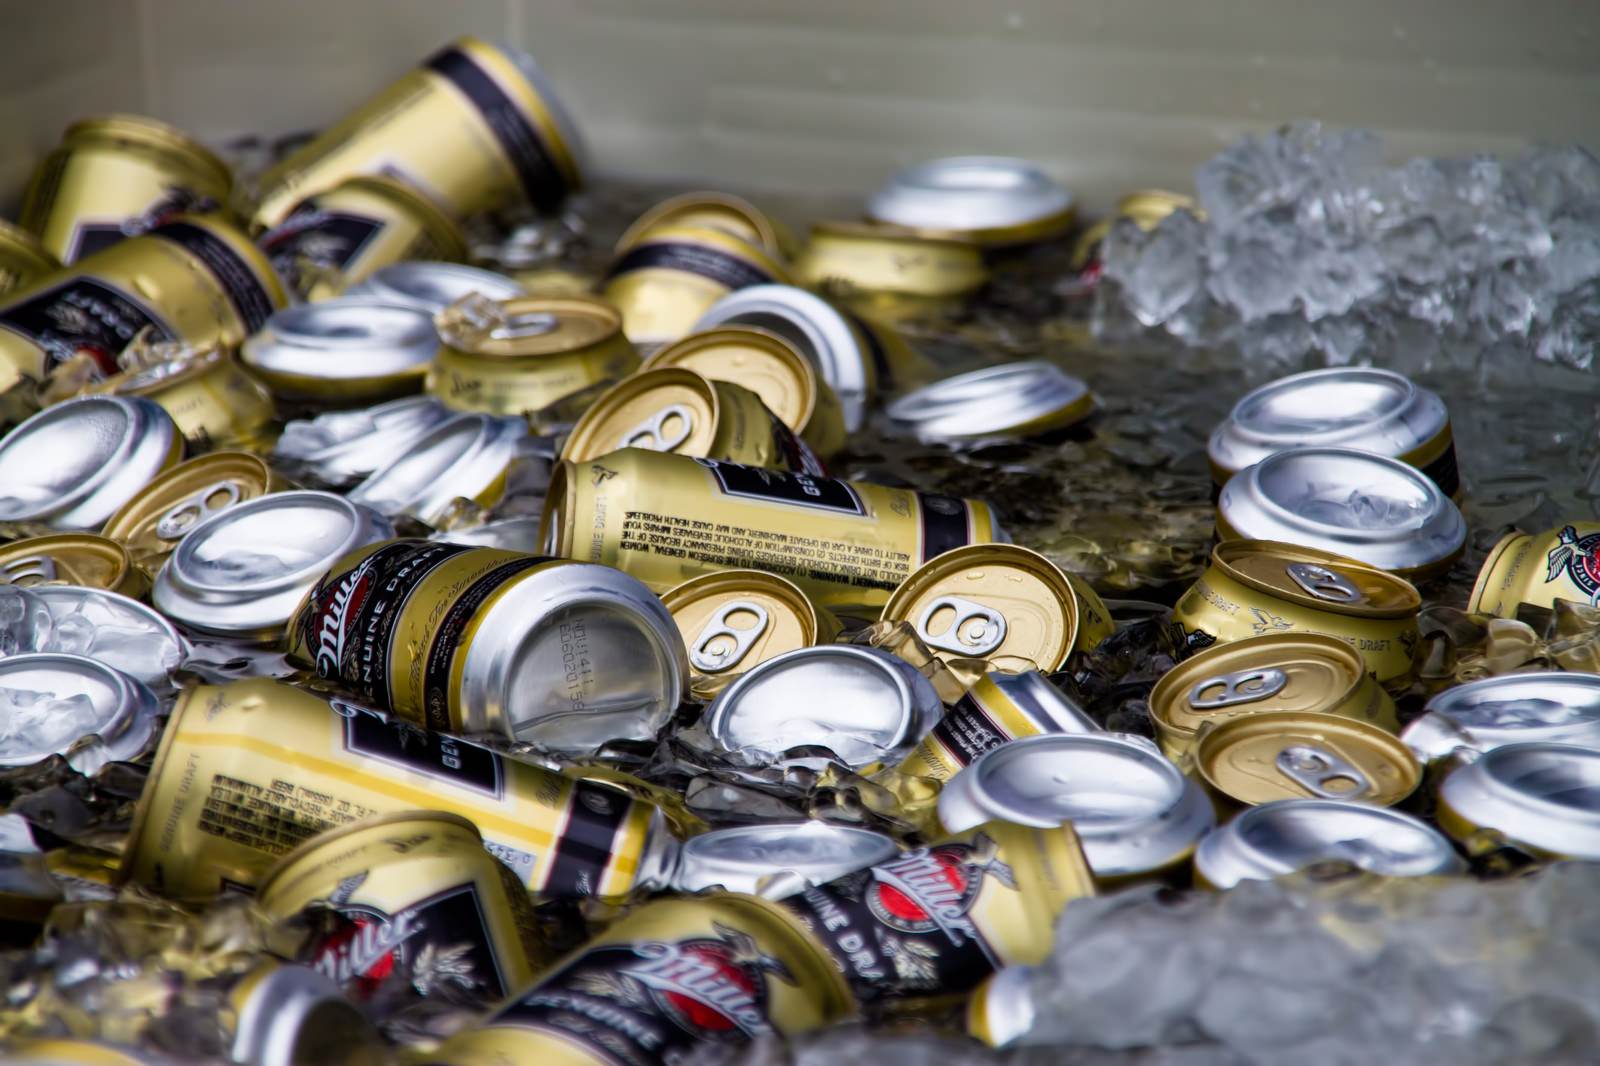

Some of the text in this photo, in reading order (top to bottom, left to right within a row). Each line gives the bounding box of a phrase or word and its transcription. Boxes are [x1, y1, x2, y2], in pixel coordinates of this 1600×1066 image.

[622, 520, 641, 530] YOUR
[664, 515, 689, 526] HEALTH
[690, 520, 714, 531] CAUSE
[642, 523, 671, 535] IMPAIRS
[715, 524, 730, 534] MAY
[731, 527, 745, 536] AND
[672, 528, 713, 541] BEVERAGES
[713, 534, 753, 547] ALCOHOLIC
[753, 541, 763, 549] OF
[788, 535, 819, 548] OPERATE
[820, 541, 830, 550] OR
[620, 541, 649, 552] WOMEN
[764, 541, 815, 556] CONSUMPTION
[831, 543, 846, 551] CAR
[846, 545, 852, 553] A
[854, 546, 873, 556] DRIVE
[621, 531, 909, 582] SHOULD NOT DRINK ALCOHOLIC BEVERAGES DURING PREGNANCY BECAUSE OF THE
[688, 550, 723, 565] SURGEON
[874, 549, 883, 557] TO
[885, 551, 911, 561] ABILITY
[724, 557, 739, 566] THE
[741, 560, 751, 568] TO
[861, 556, 881, 566] BIRTH
[882, 560, 892, 568] OF
[894, 562, 910, 571] RISK
[809, 570, 849, 585] WARNING:
[316, 556, 382, 679] Miller
[364, 600, 387, 697] ENUINE
[1360, 639, 1392, 652] DRAFT
[871, 847, 976, 947] Miller
